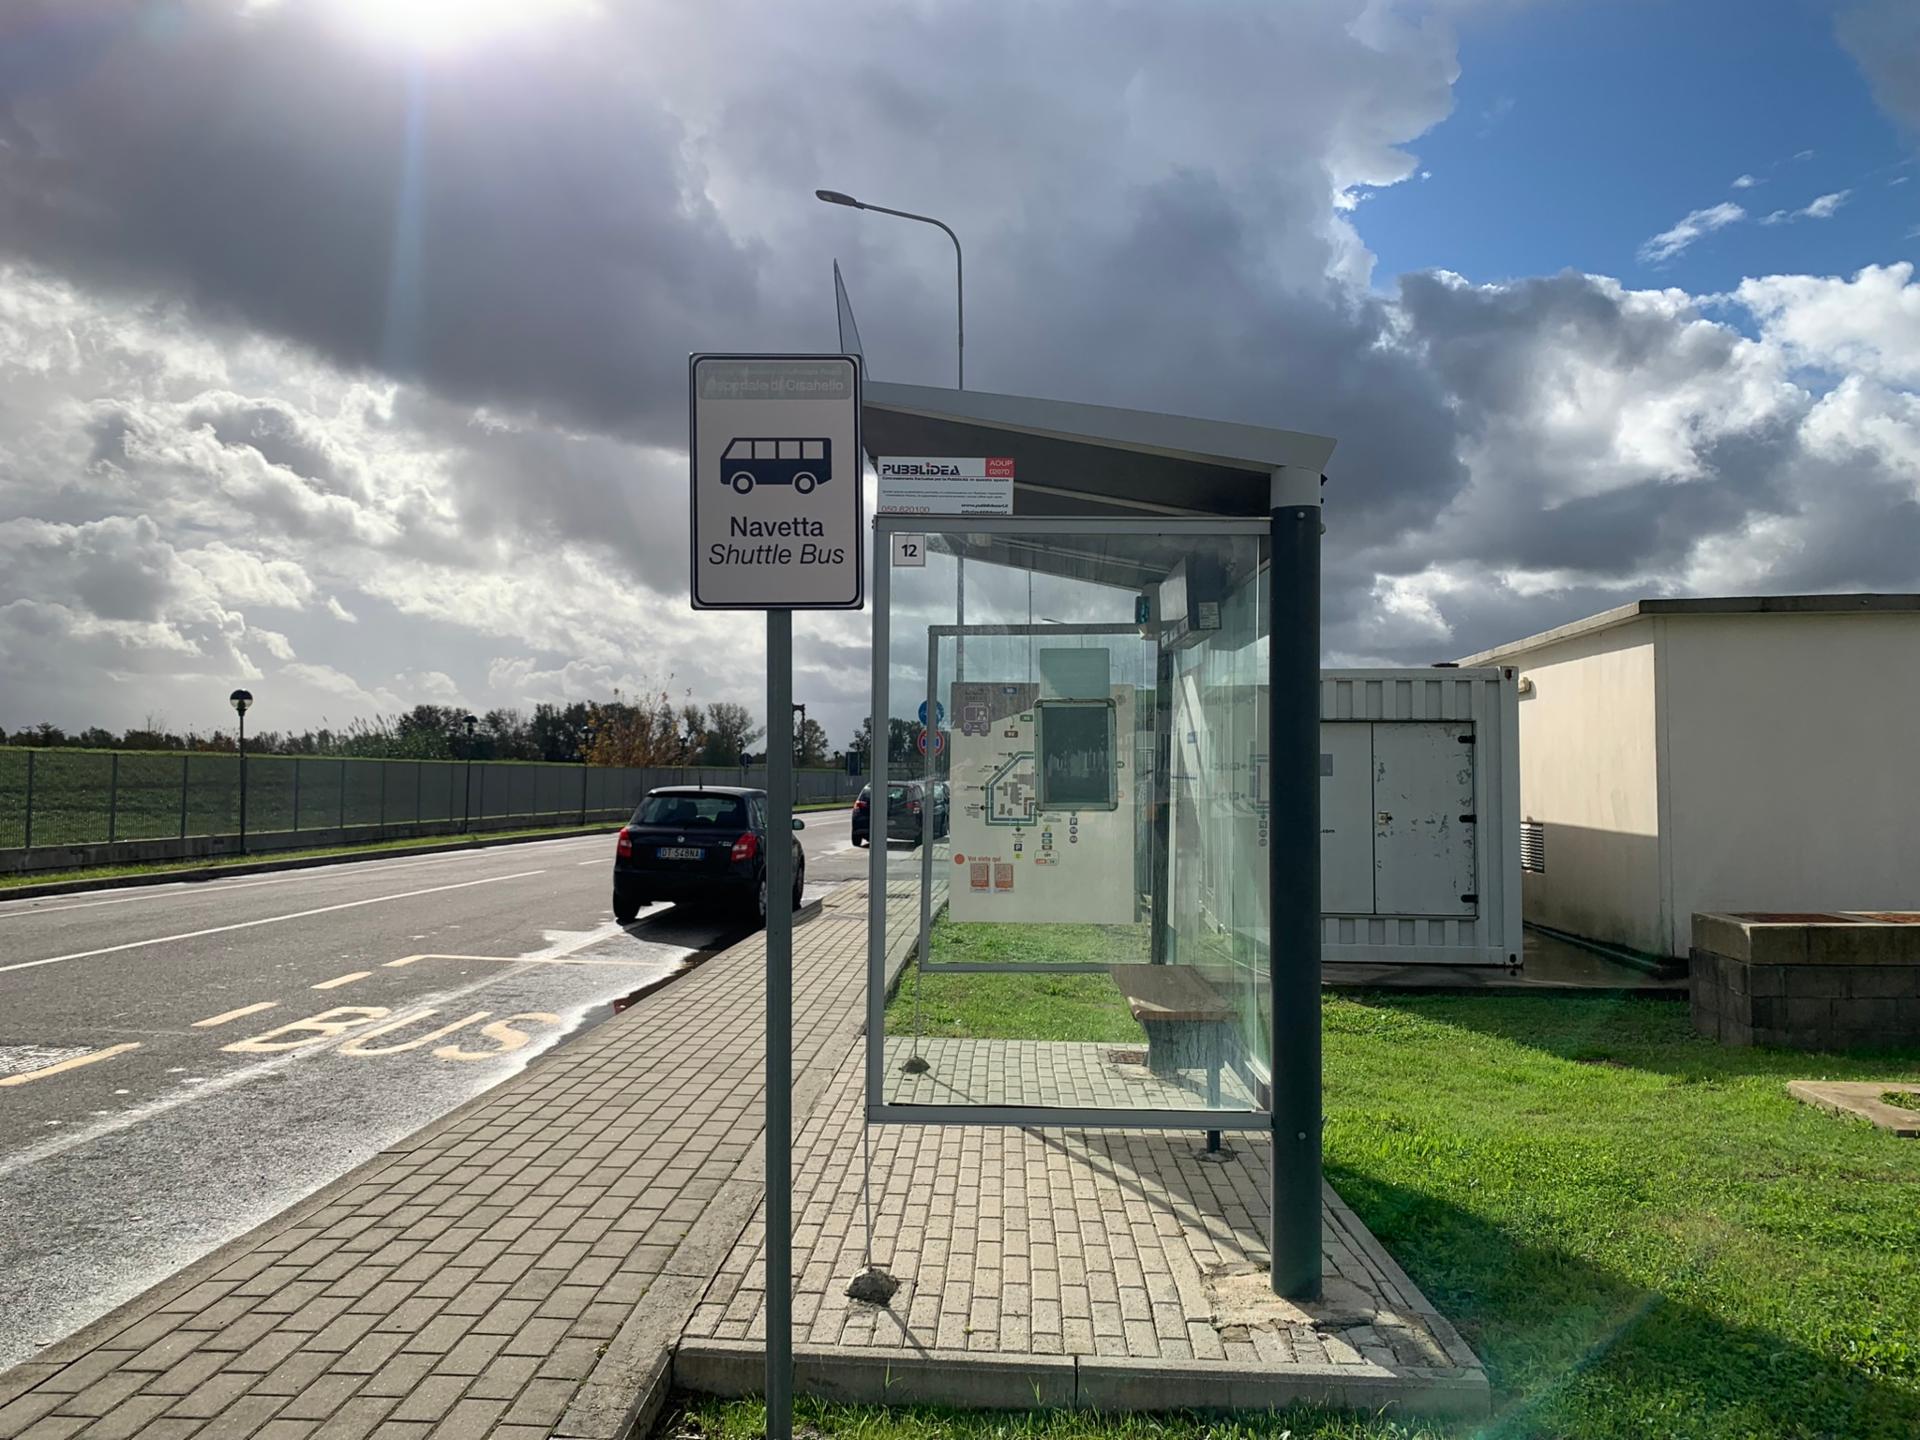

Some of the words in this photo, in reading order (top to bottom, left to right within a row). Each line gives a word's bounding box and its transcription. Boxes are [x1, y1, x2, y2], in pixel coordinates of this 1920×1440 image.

[730, 516, 824, 537] Navetta
[708, 543, 792, 565] Shuttle
[800, 543, 845, 564] Bus
[901, 544, 917, 557] 12
[220, 1005, 561, 1061] BUS
